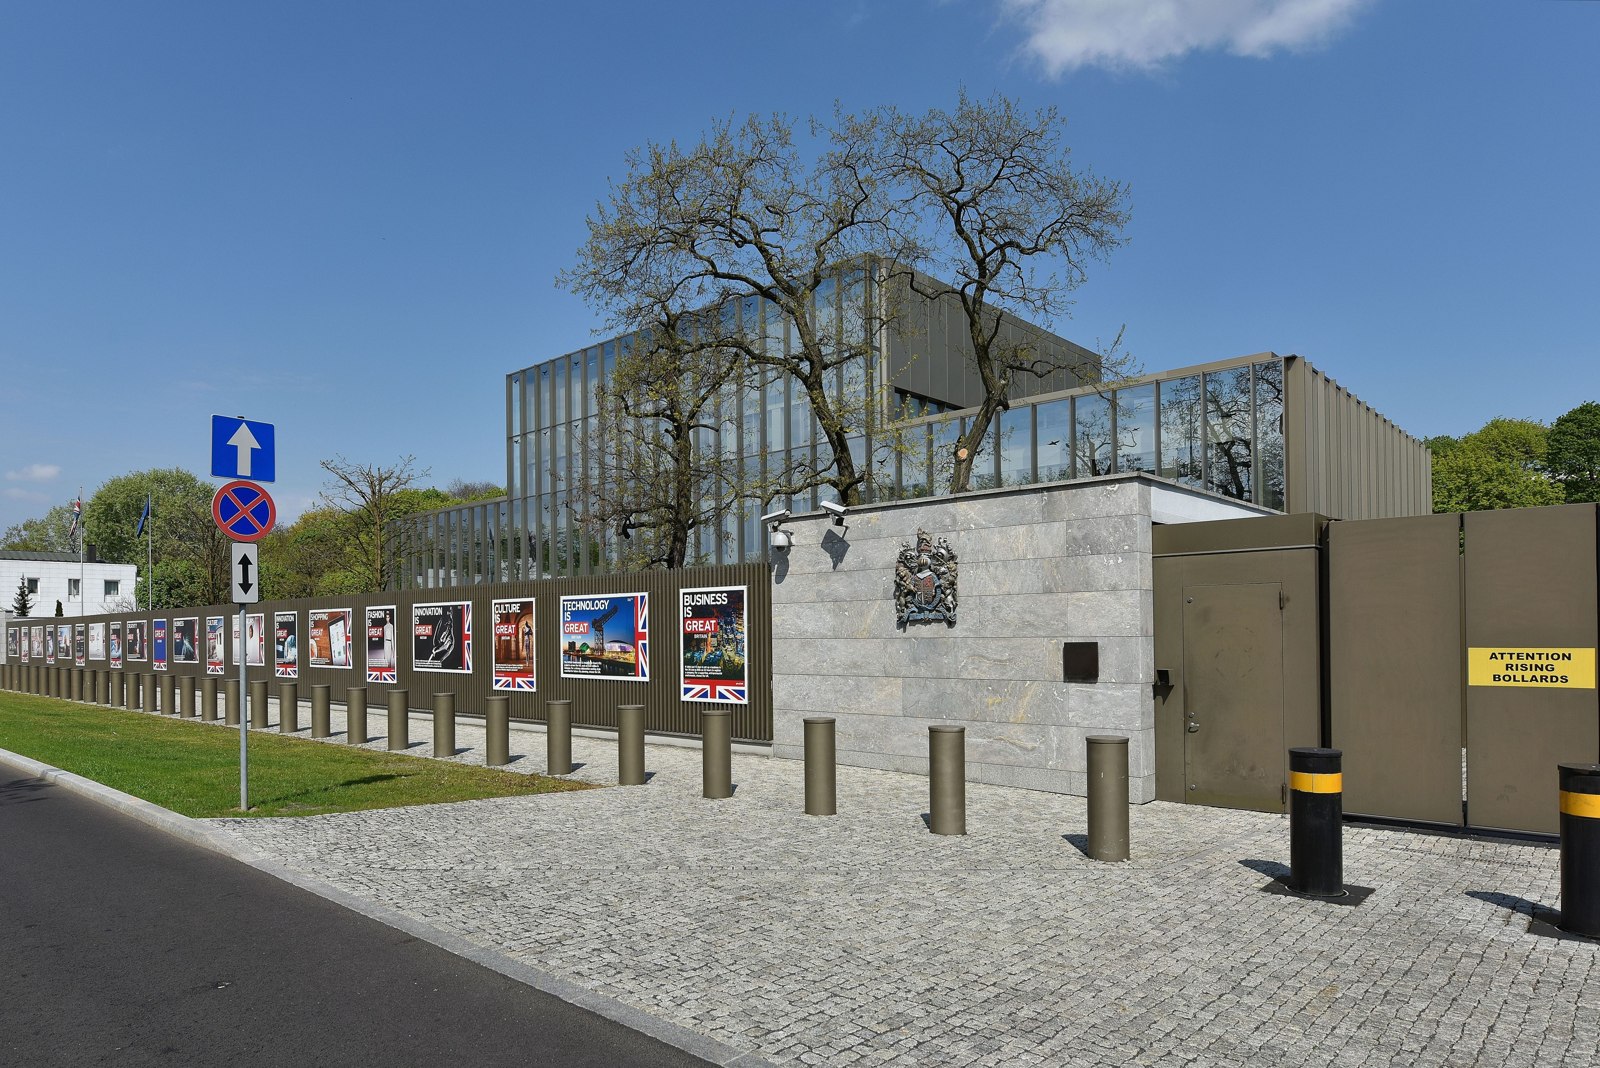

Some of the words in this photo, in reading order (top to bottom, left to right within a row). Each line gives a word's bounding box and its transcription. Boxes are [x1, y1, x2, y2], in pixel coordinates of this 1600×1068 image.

[684, 593, 728, 606] BUSINESS
[494, 604, 520, 614] CULTURE
[563, 600, 610, 611] TECHNOLOGY
[368, 610, 384, 618] FASHION
[414, 606, 442, 616] INNOVATION
[684, 606, 692, 618] IS
[414, 616, 420, 624] IS
[494, 614, 501, 623] IS
[564, 612, 571, 621] IS
[415, 626, 432, 634] GREAT
[496, 624, 516, 634] GREAT
[564, 623, 588, 633] GREAT
[685, 620, 716, 632] GREAT
[311, 628, 323, 636] GREAT
[368, 628, 382, 636] GREAT
[1505, 664, 1555, 672] RISING
[1492, 674, 1568, 683] BOLLARDS
